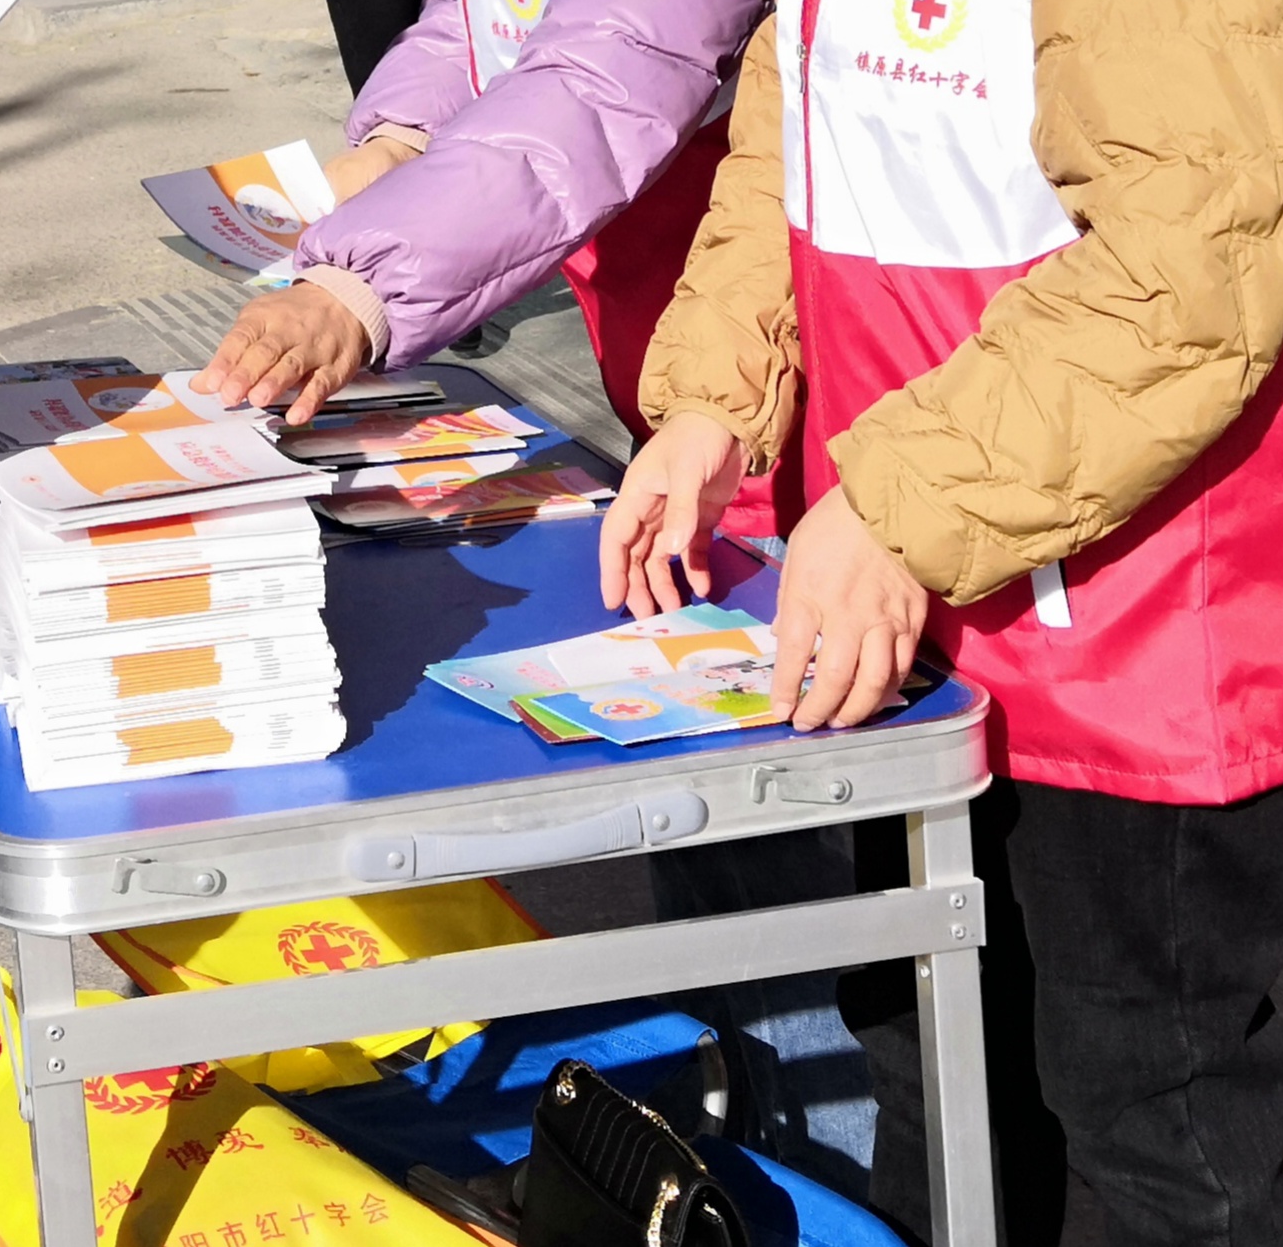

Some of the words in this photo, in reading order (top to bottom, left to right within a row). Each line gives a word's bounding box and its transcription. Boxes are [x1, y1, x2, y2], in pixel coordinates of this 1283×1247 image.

[854, 50, 989, 101] 镇原县红十字会
[162, 1192, 391, 1247] 阳市红十字会
